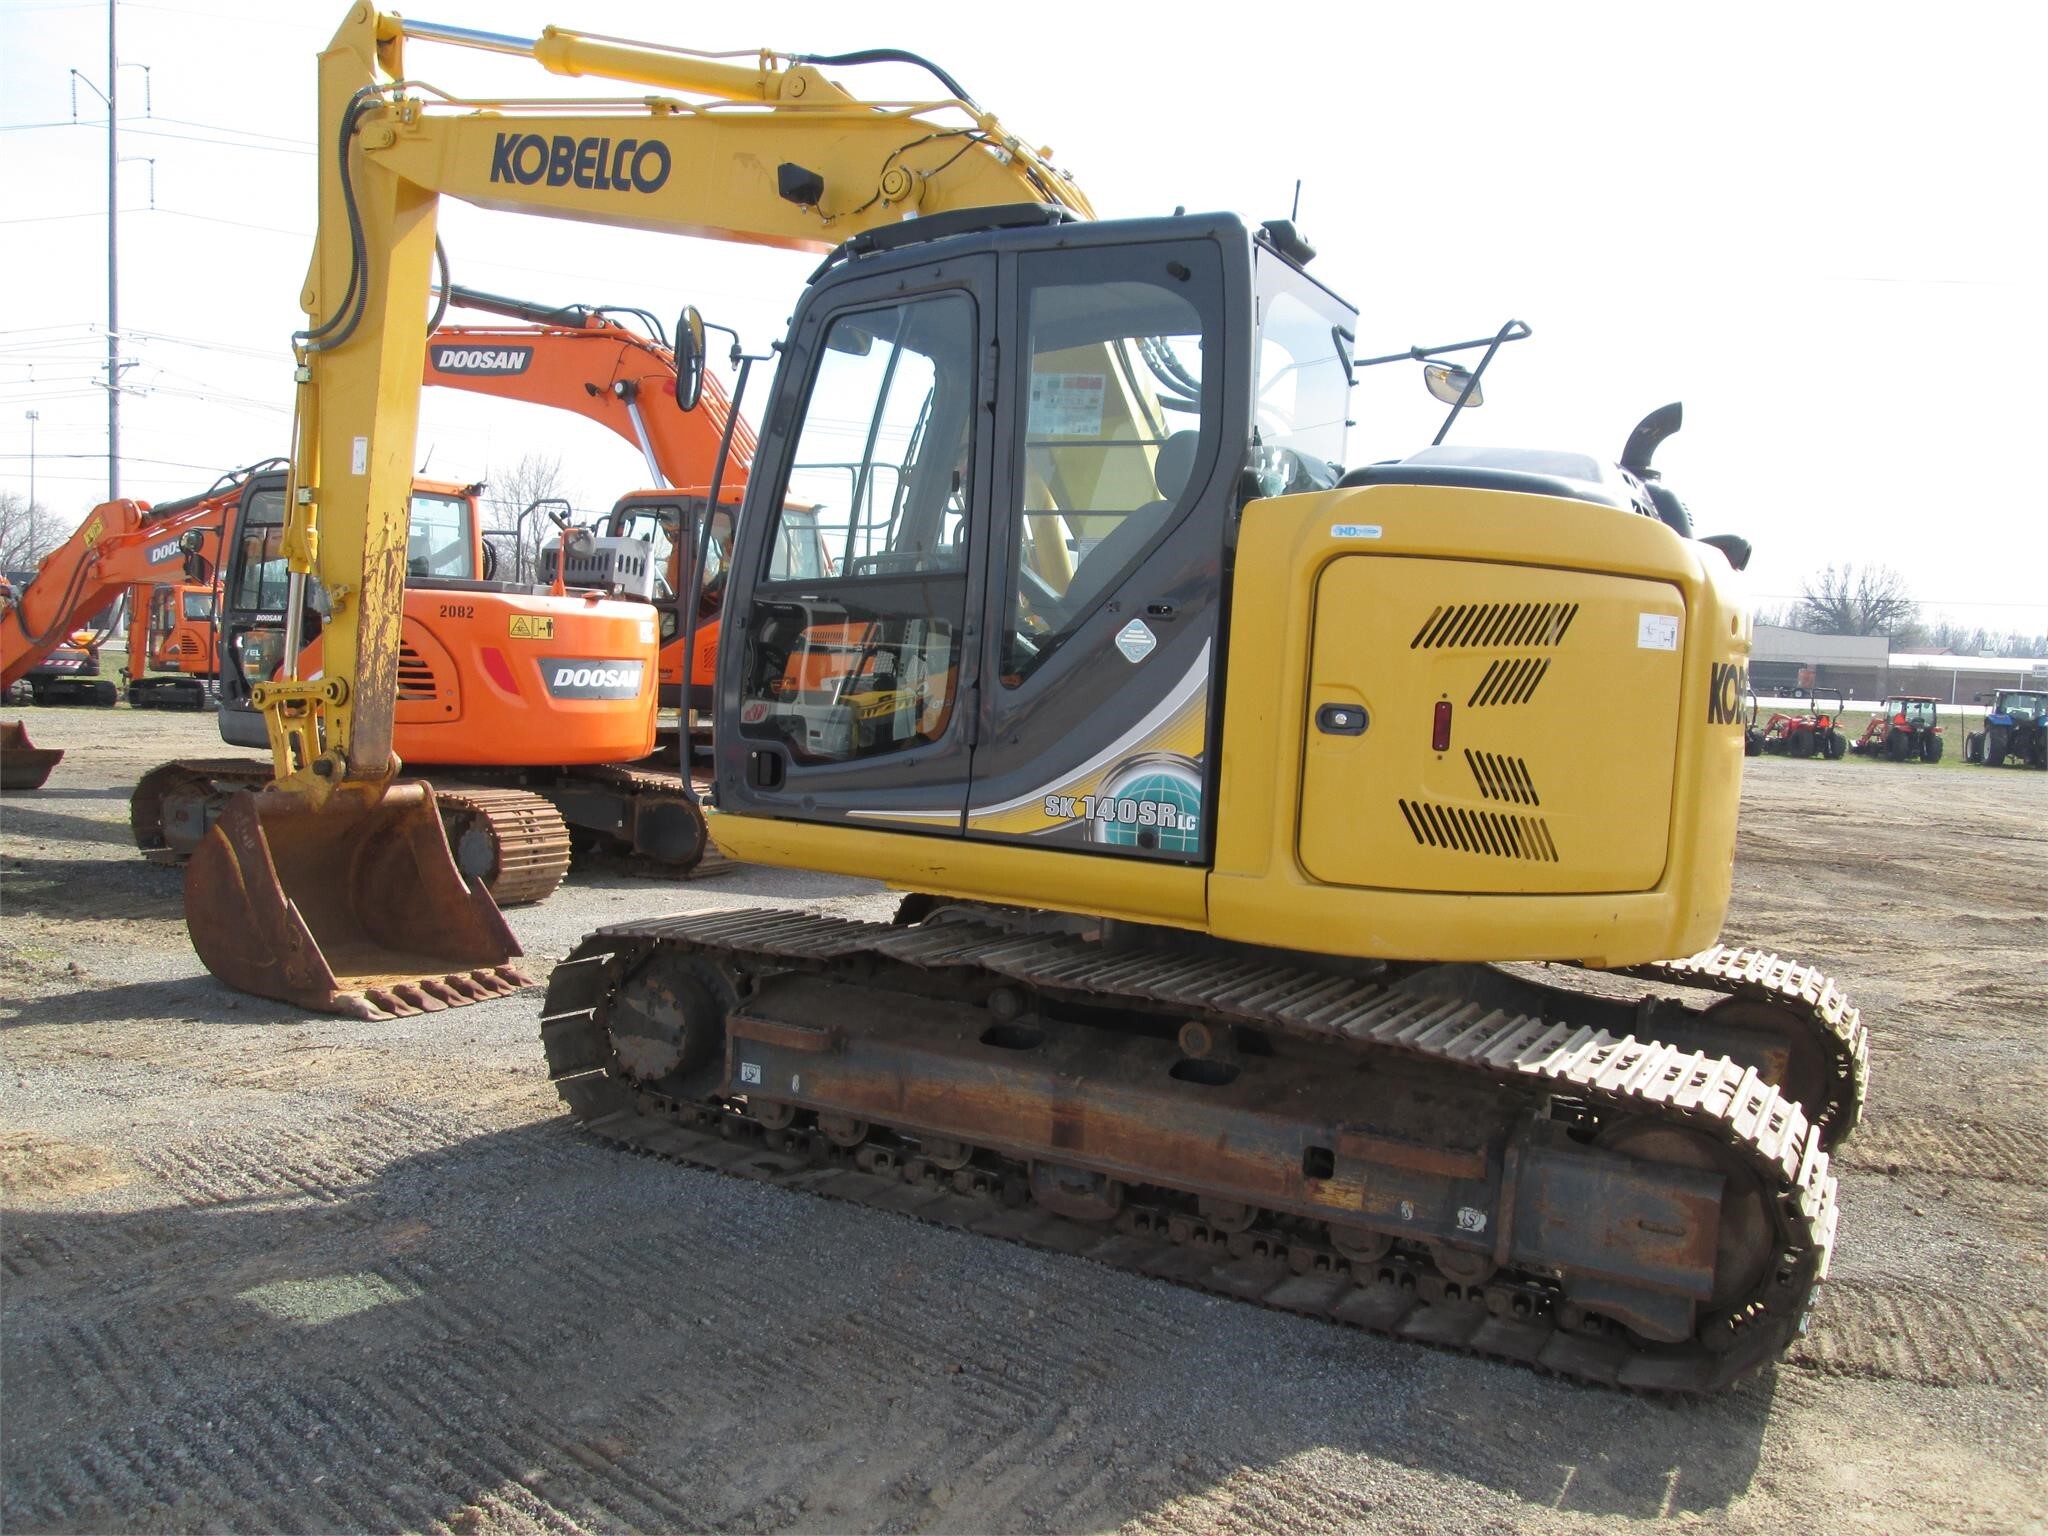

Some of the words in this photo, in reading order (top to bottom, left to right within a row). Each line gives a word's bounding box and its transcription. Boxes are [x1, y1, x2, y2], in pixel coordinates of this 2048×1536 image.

[490, 132, 672, 194] KOBELCO
[438, 350, 526, 369] DOOSAN
[151, 540, 182, 562] DOOS
[255, 614, 283, 622] DOOSAN
[439, 604, 475, 619] 2082
[553, 668, 642, 688] DOOSAN
[1045, 795, 1077, 818] SK
